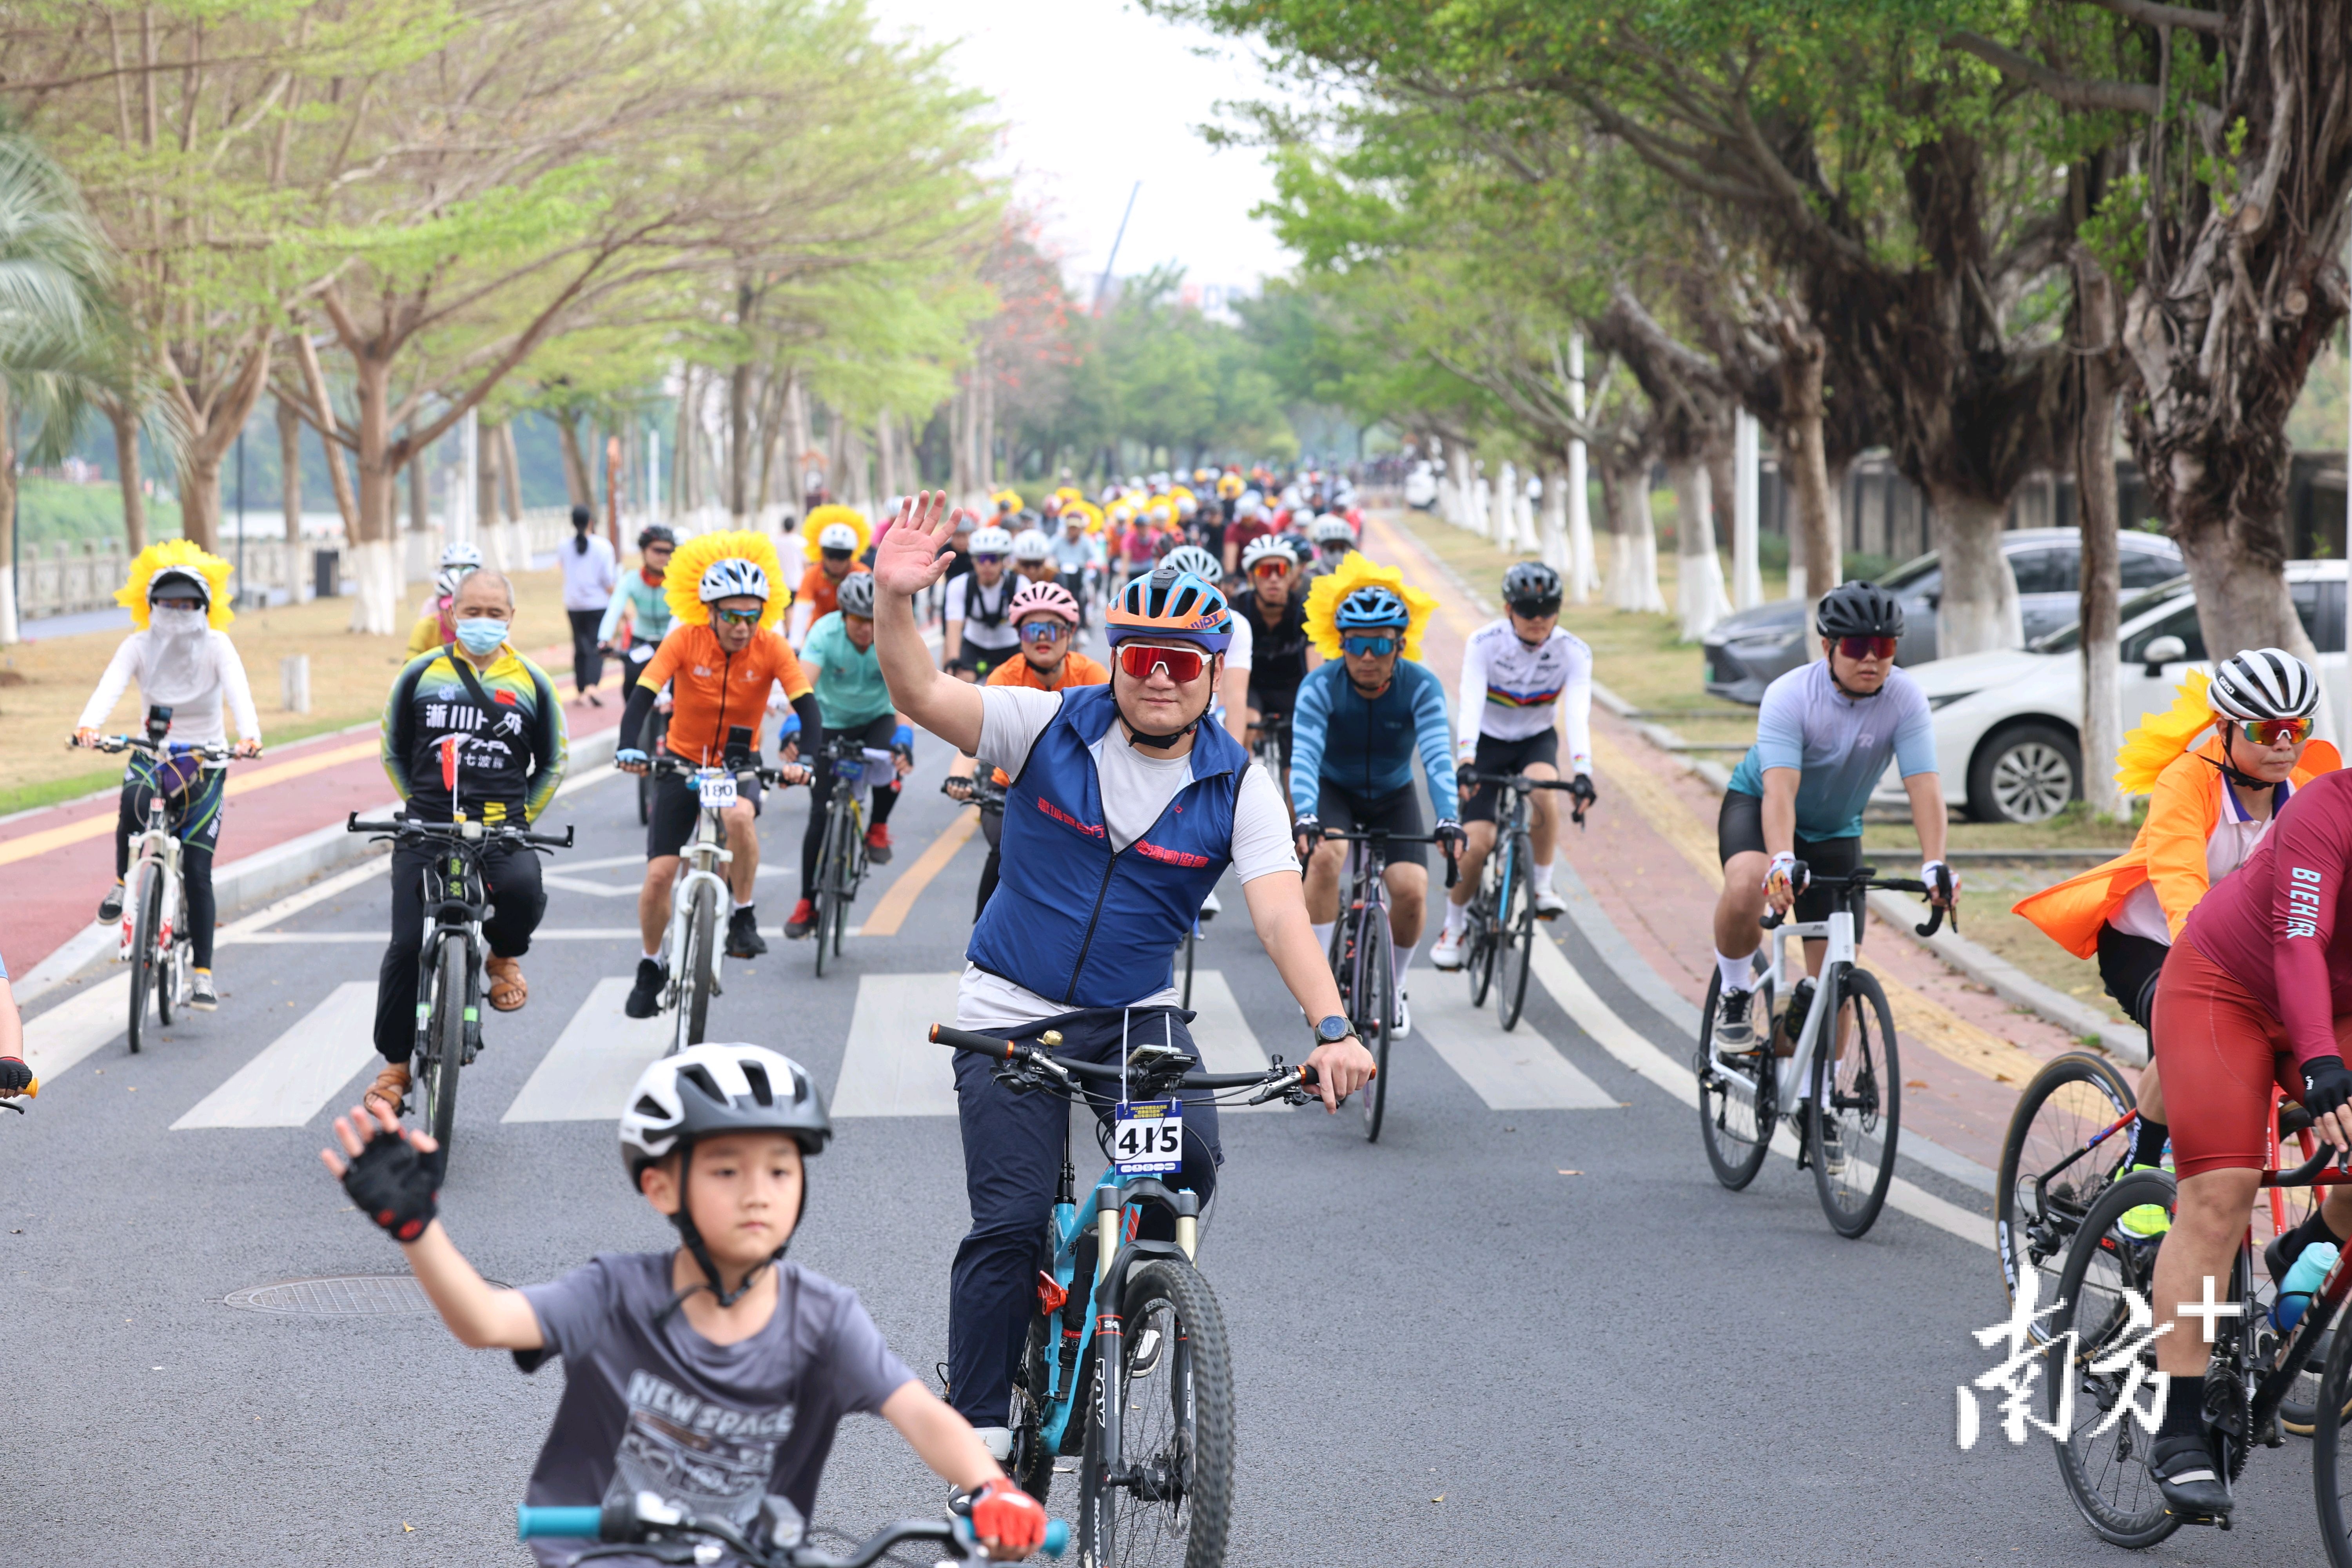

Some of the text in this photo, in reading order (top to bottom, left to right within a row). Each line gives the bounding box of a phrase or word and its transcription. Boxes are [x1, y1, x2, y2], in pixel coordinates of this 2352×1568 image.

[704, 784, 732, 797] 180
[1119, 1126, 1178, 1154] 415
[629, 1370, 794, 1435] NEW SPACE
